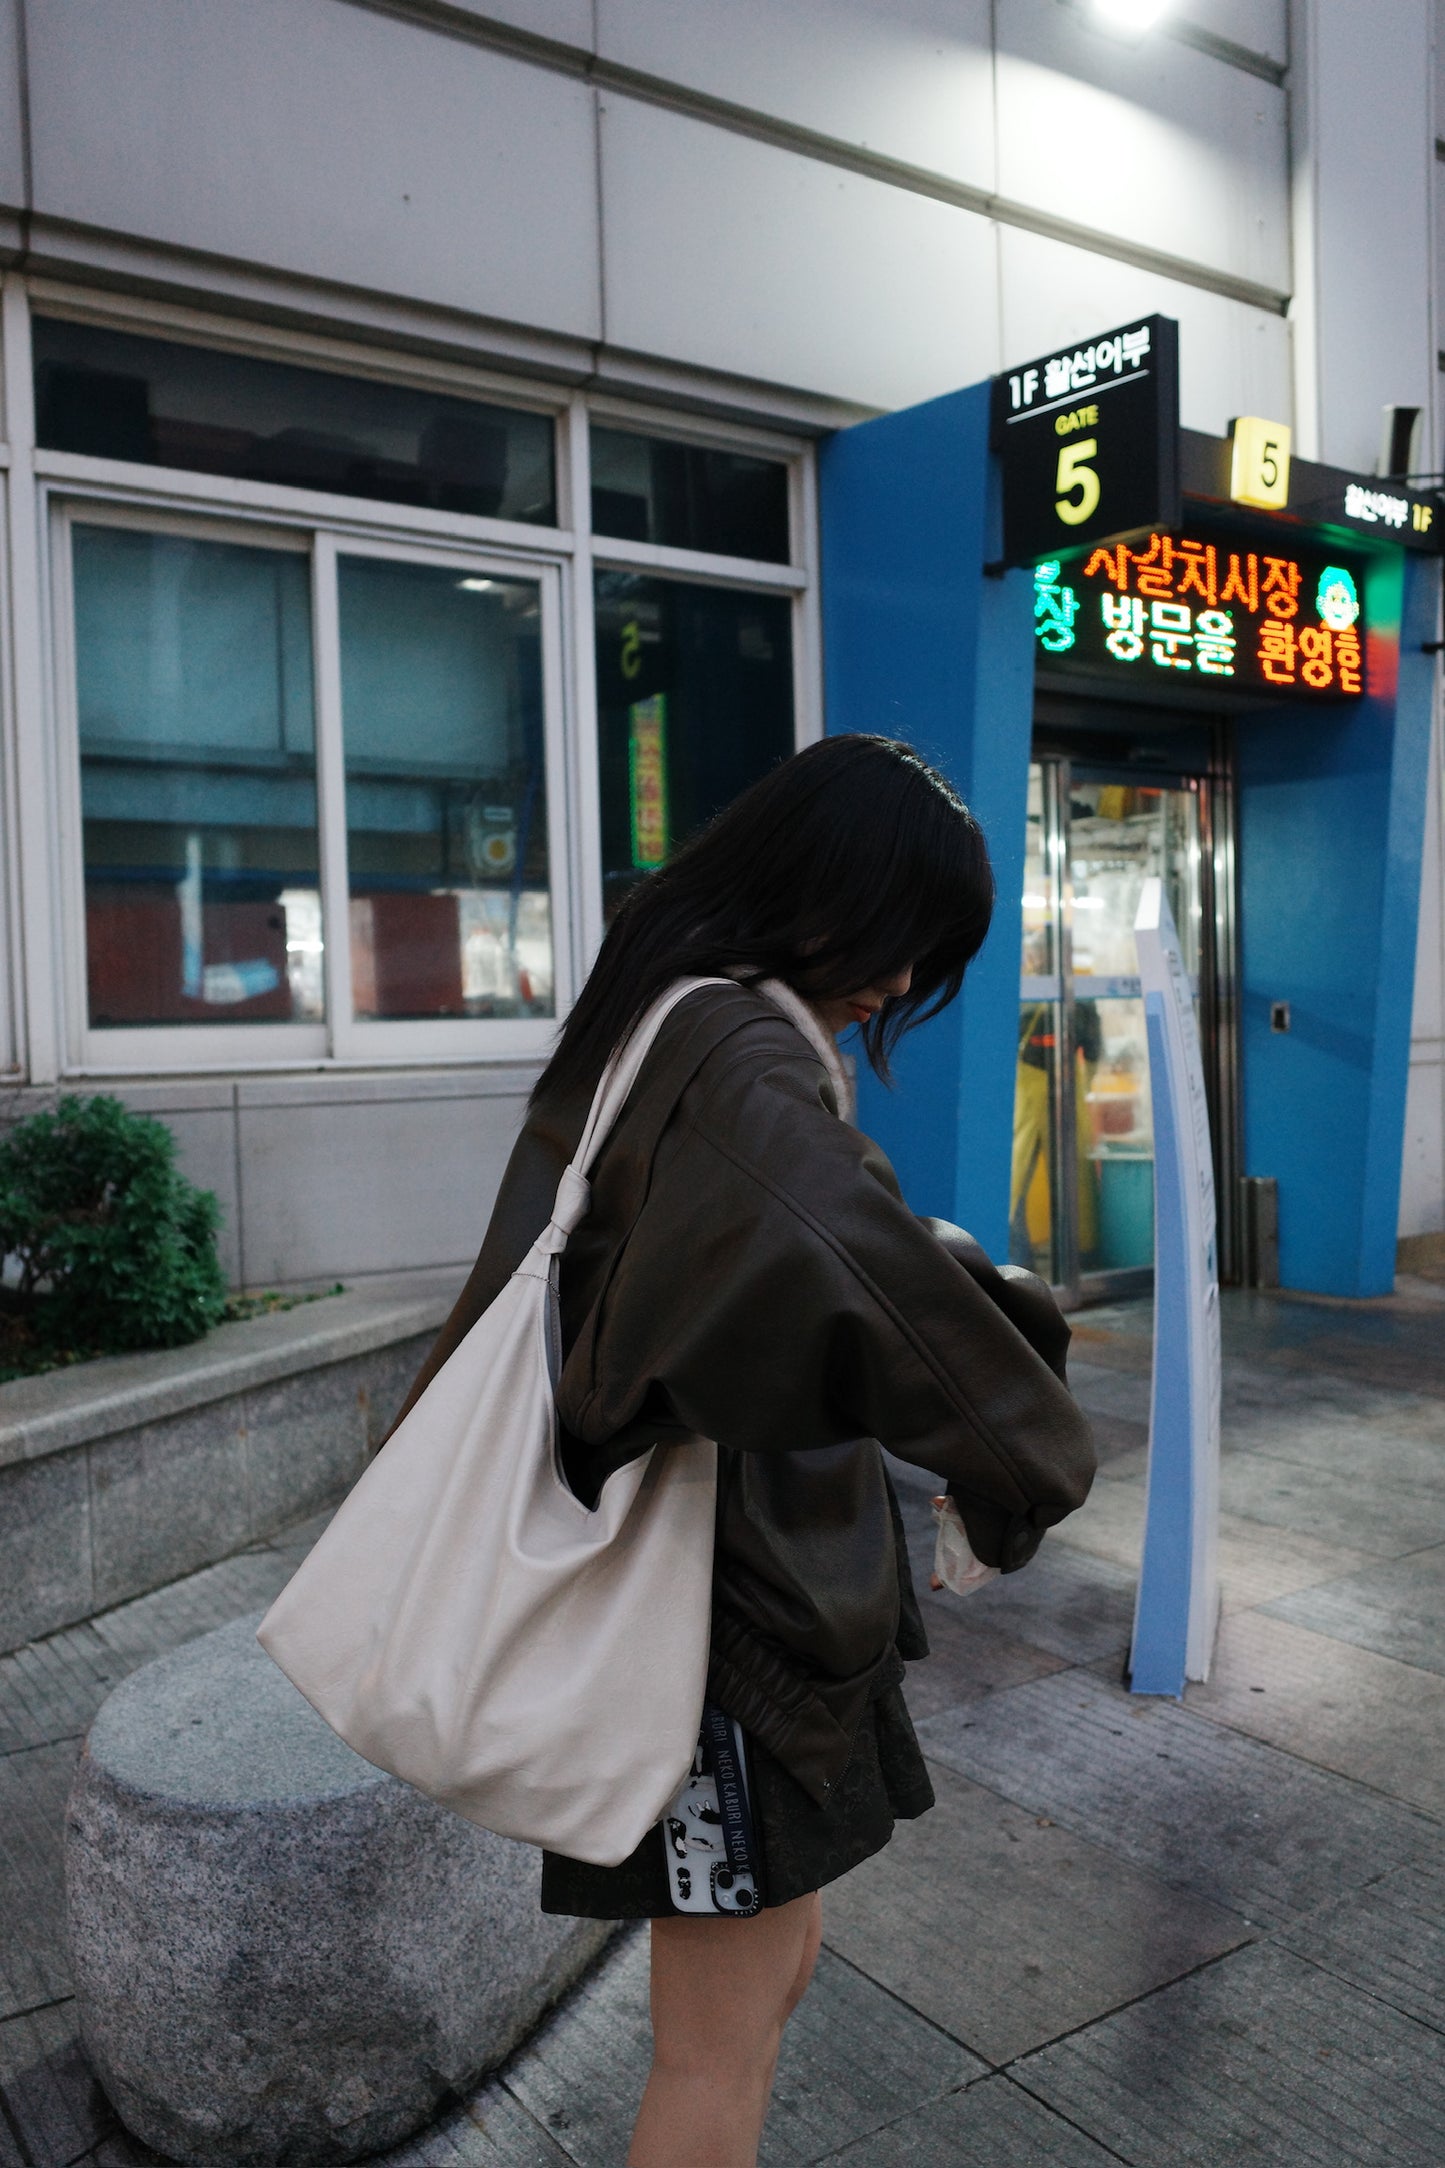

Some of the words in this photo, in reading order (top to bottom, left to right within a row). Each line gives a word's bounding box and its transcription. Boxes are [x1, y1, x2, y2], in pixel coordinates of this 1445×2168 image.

[1008, 368, 1039, 409] 1F
[1044, 325, 1151, 398] 활선어부
[1054, 404, 1099, 436] GATE
[1055, 437, 1101, 526] 5
[1260, 441, 1279, 488] 5
[1412, 503, 1433, 533] 1F
[1102, 592, 1237, 677] 방문을
[710, 1708, 728, 1742] ABURI
[717, 1750, 735, 1779] NEKO
[723, 1782, 743, 1825] KABURI
[731, 1830, 749, 1861] NEKO
